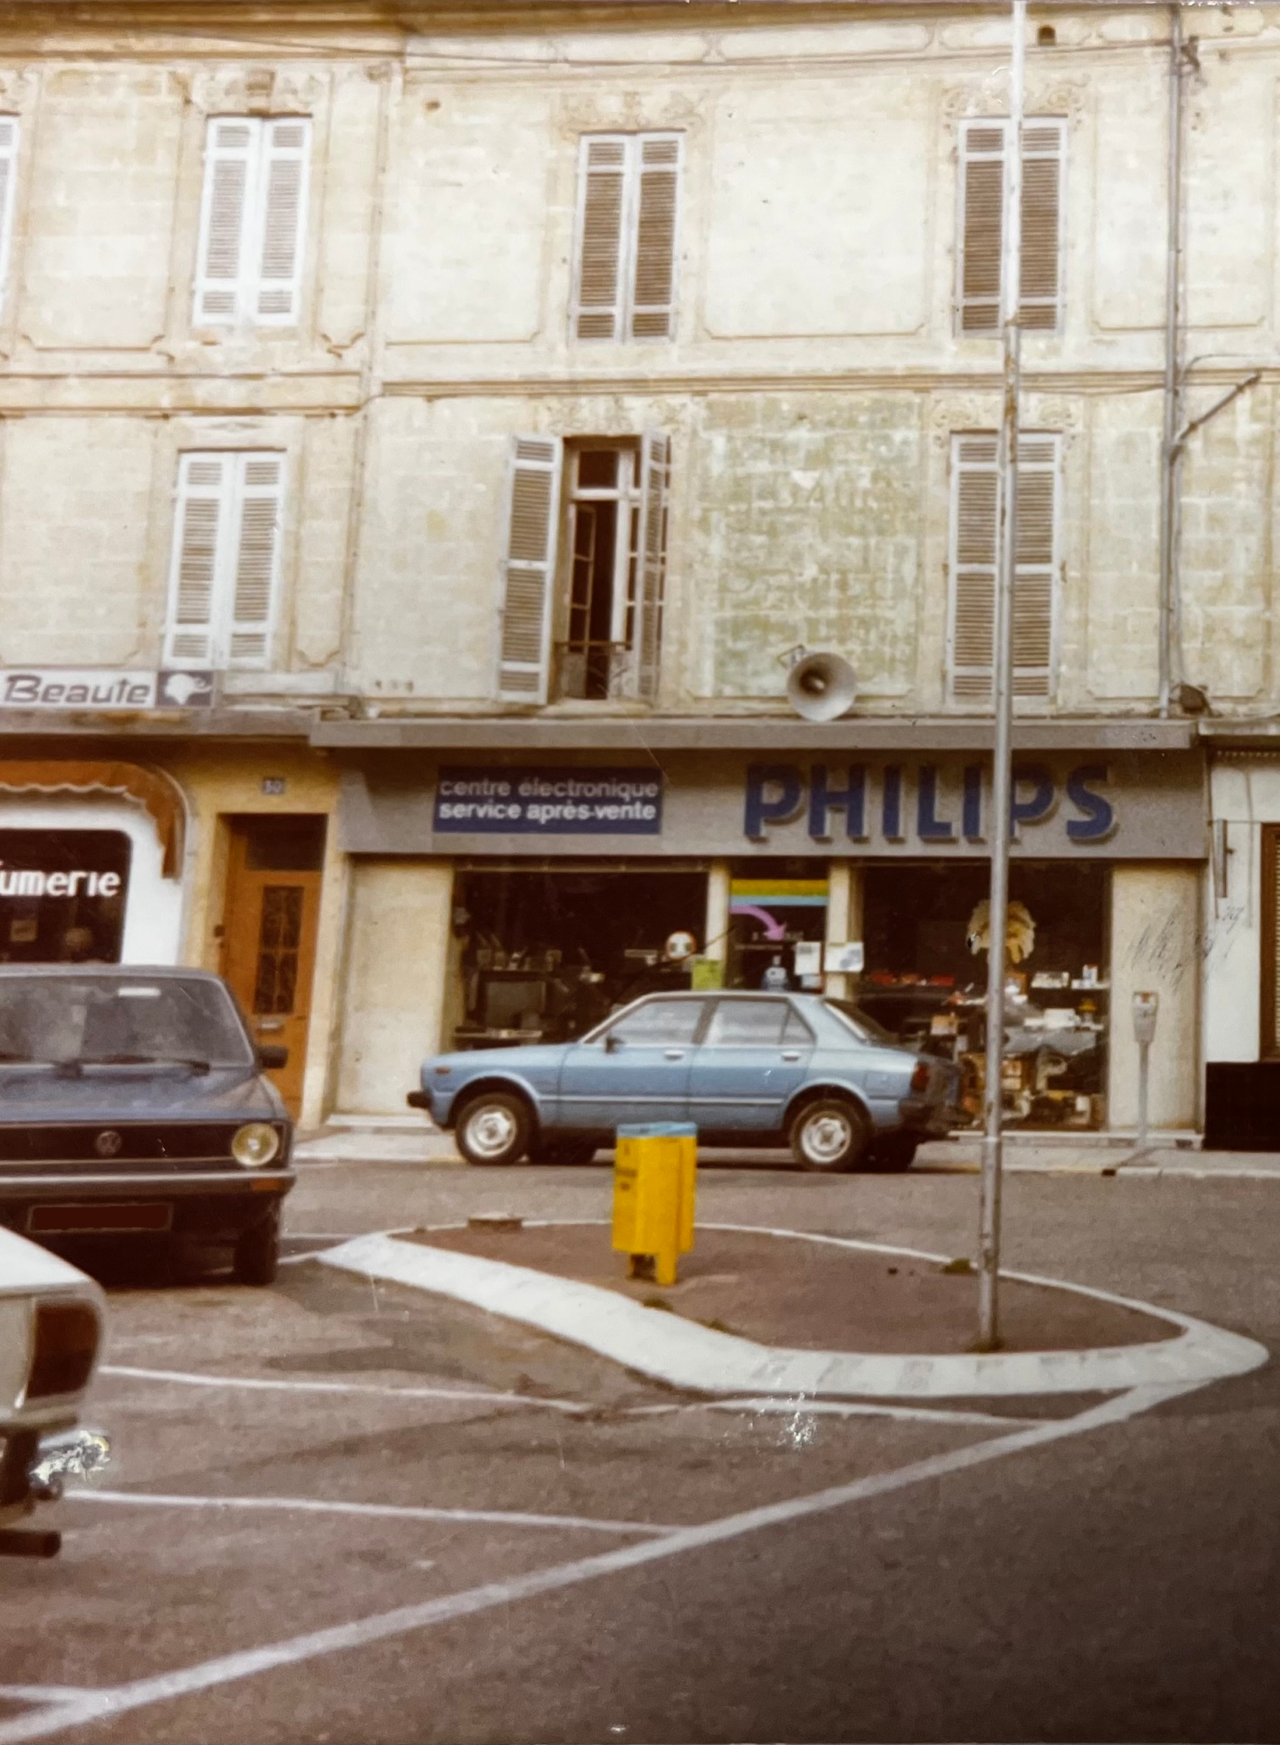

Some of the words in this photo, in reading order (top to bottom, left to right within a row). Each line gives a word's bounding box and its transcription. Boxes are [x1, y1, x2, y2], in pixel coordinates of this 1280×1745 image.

[440, 778, 511, 797] centre
[518, 777, 658, 802] électronique
[744, 763, 1117, 840] PHILIPS
[439, 798, 521, 820] service
[526, 800, 656, 824] après-vente
[0, 861, 121, 897] umerie
